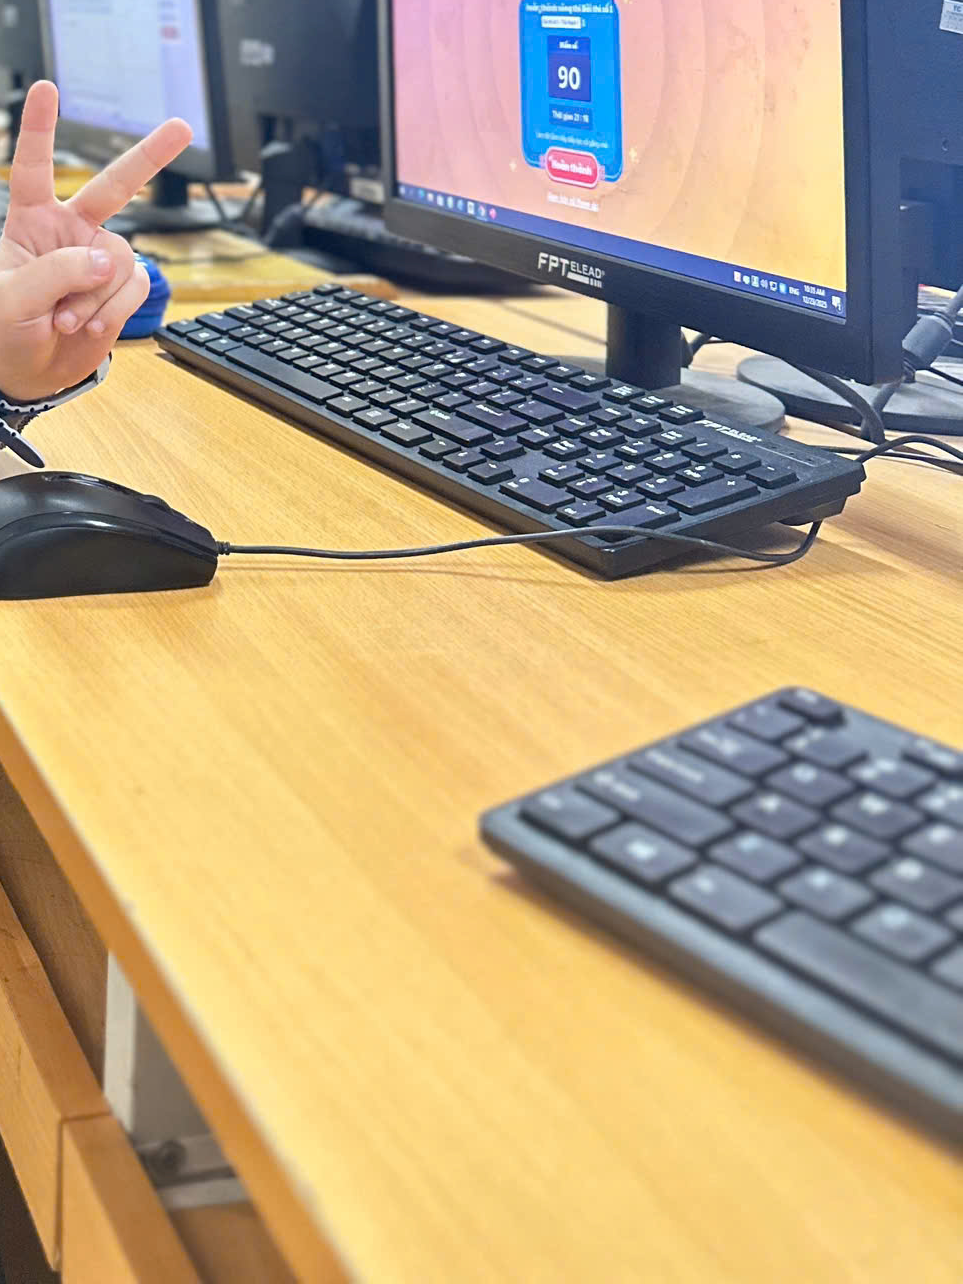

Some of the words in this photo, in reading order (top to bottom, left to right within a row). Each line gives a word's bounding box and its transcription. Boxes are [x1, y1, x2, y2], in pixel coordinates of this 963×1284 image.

[558, 65, 580, 90] 90
[537, 252, 569, 277] FPT
[570, 261, 603, 279] ELEAD
